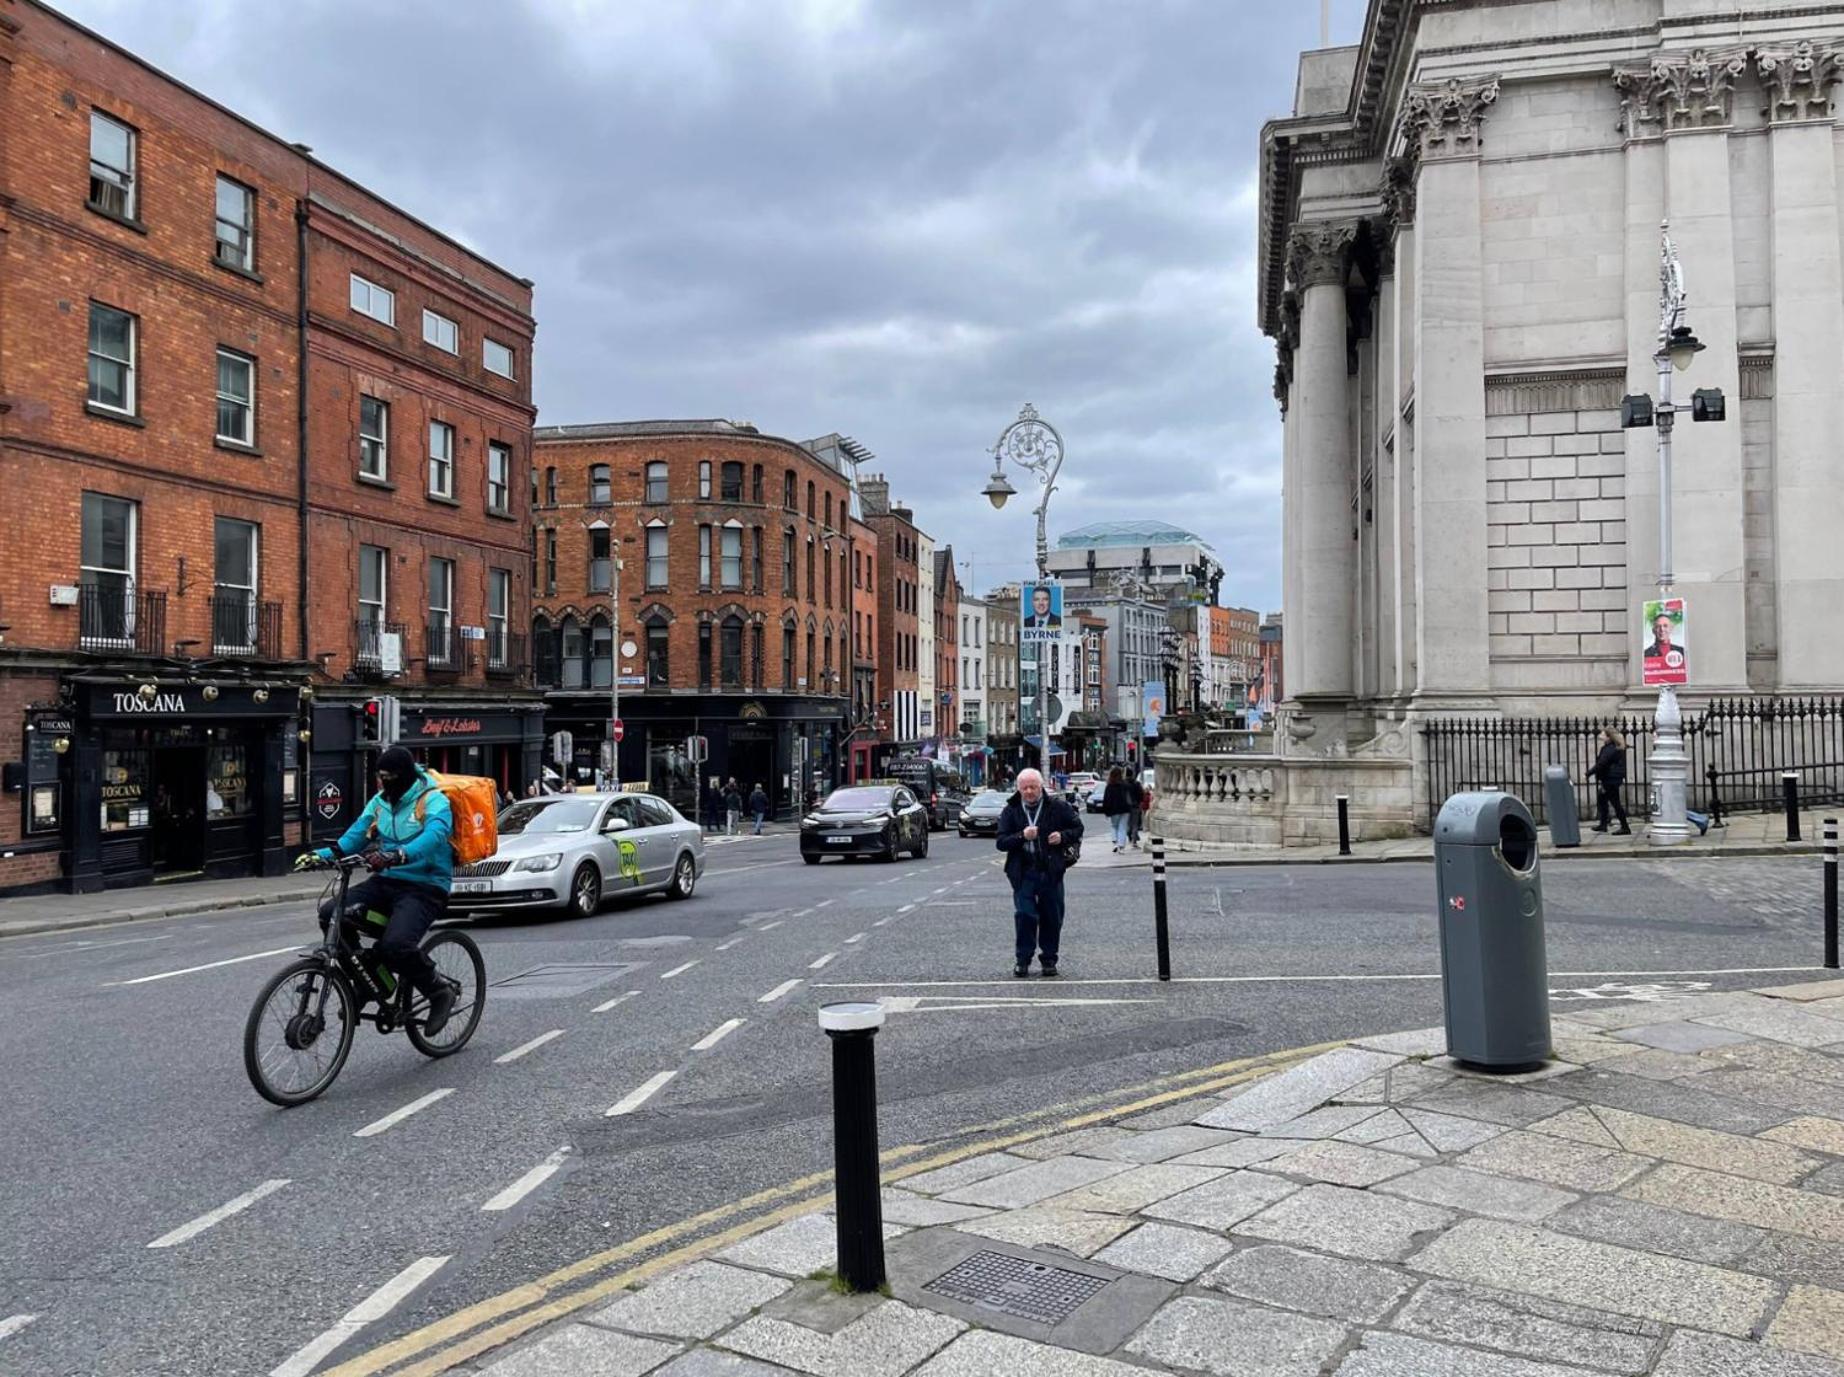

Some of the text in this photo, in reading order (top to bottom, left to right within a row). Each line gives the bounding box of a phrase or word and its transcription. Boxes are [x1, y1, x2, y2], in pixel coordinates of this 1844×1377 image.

[1023, 630, 1061, 639] BYRNE
[113, 693, 185, 712] TOSCANA
[40, 720, 71, 730] TOSCANA
